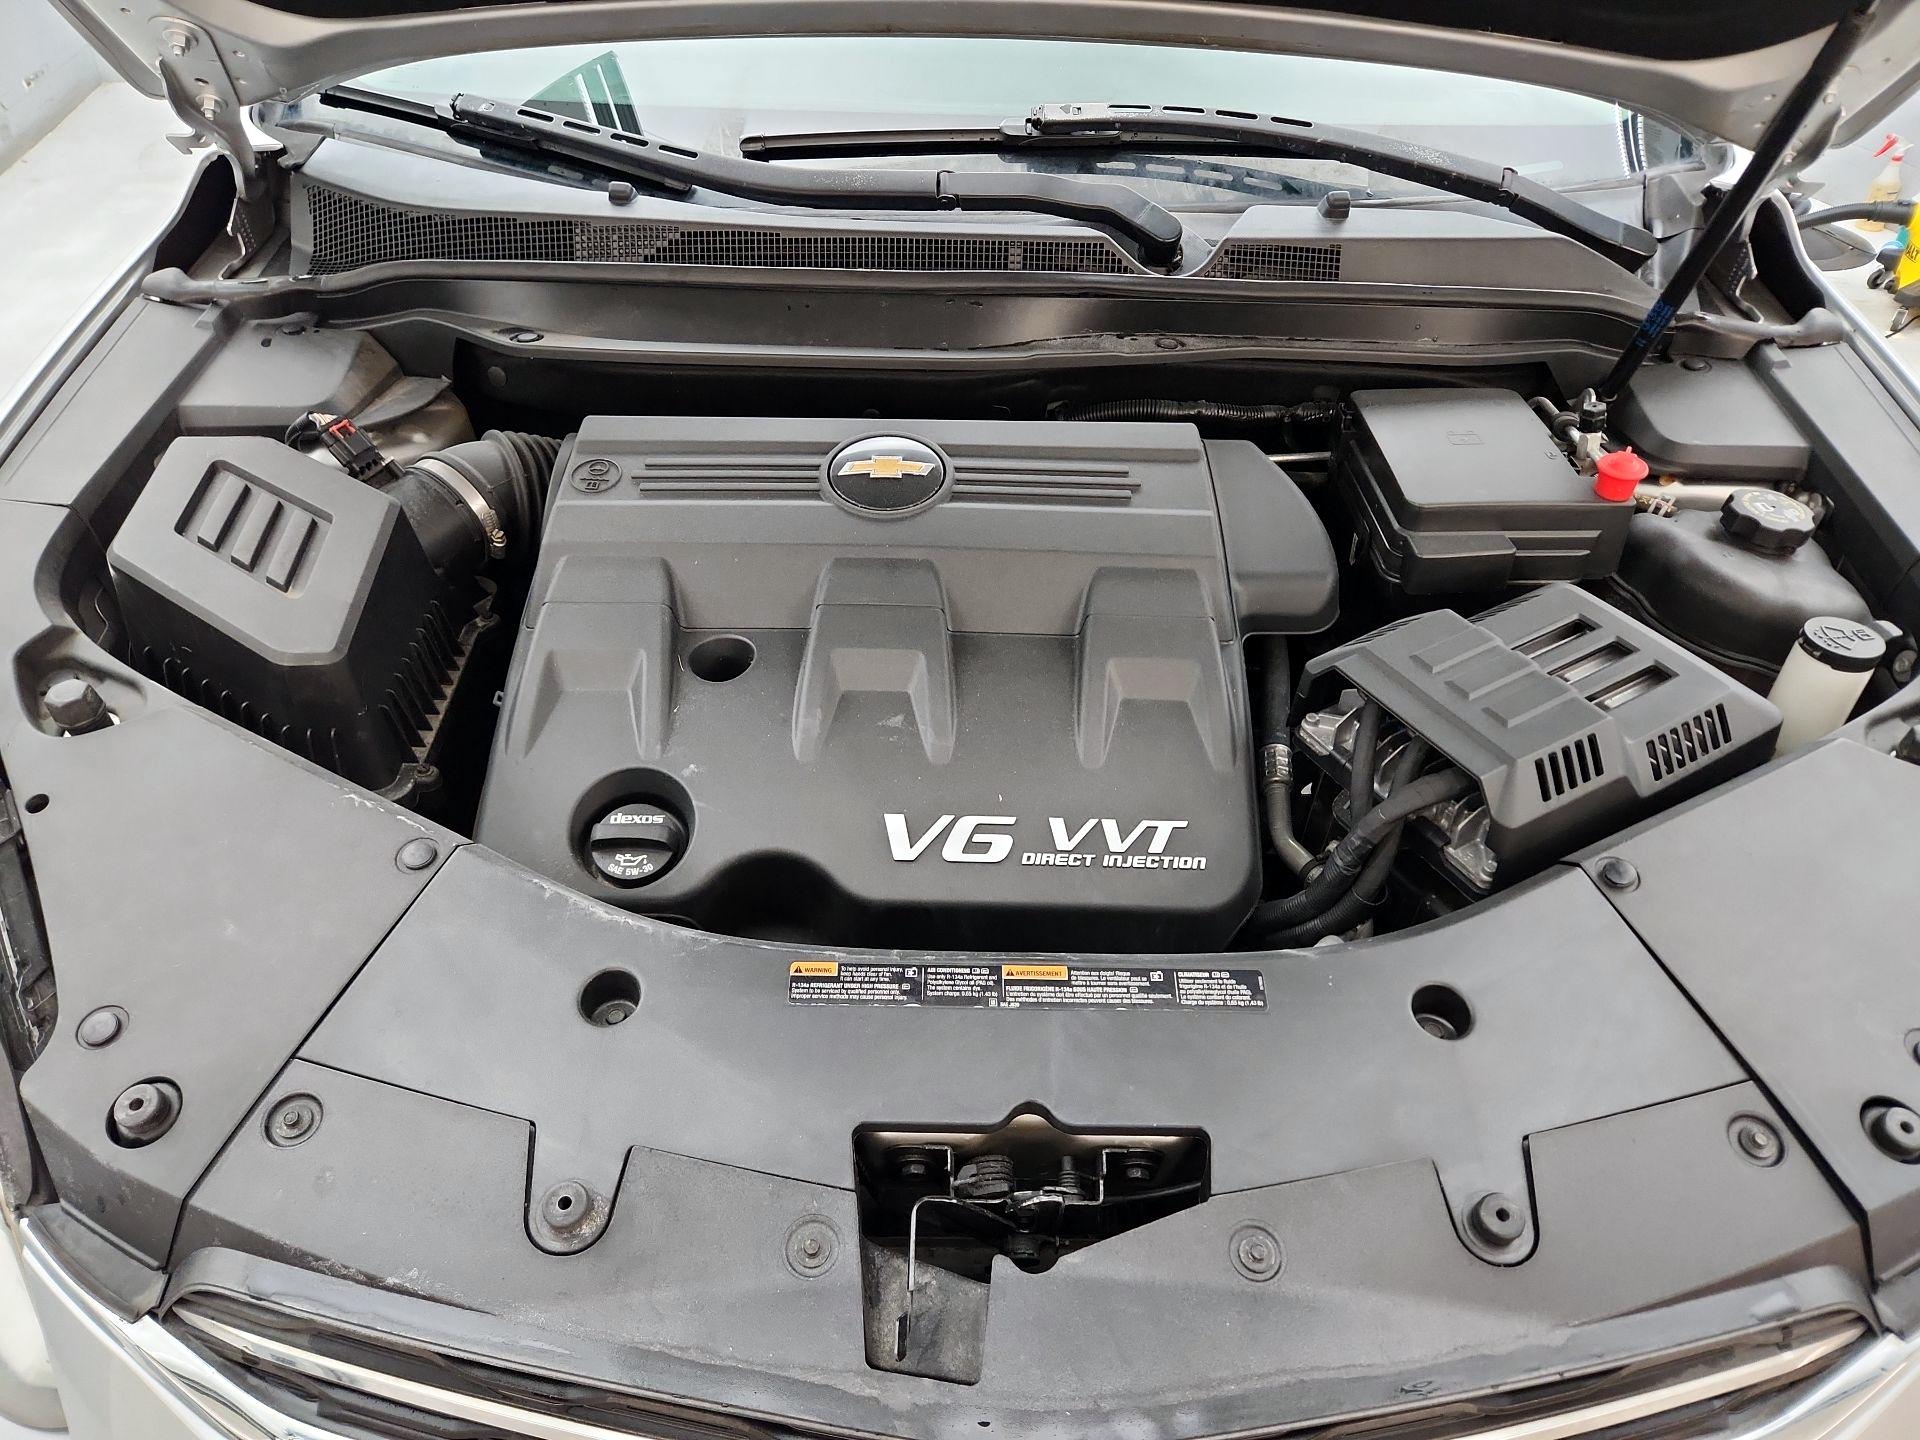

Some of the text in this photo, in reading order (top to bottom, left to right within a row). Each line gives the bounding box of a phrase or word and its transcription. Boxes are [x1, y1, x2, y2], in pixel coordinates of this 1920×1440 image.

[610, 813, 665, 824] dexos
[884, 813, 1189, 863] V6 VVT
[1021, 852, 1207, 870] DIRECT INJECTION
[607, 864, 654, 875] SAE 5W-30
